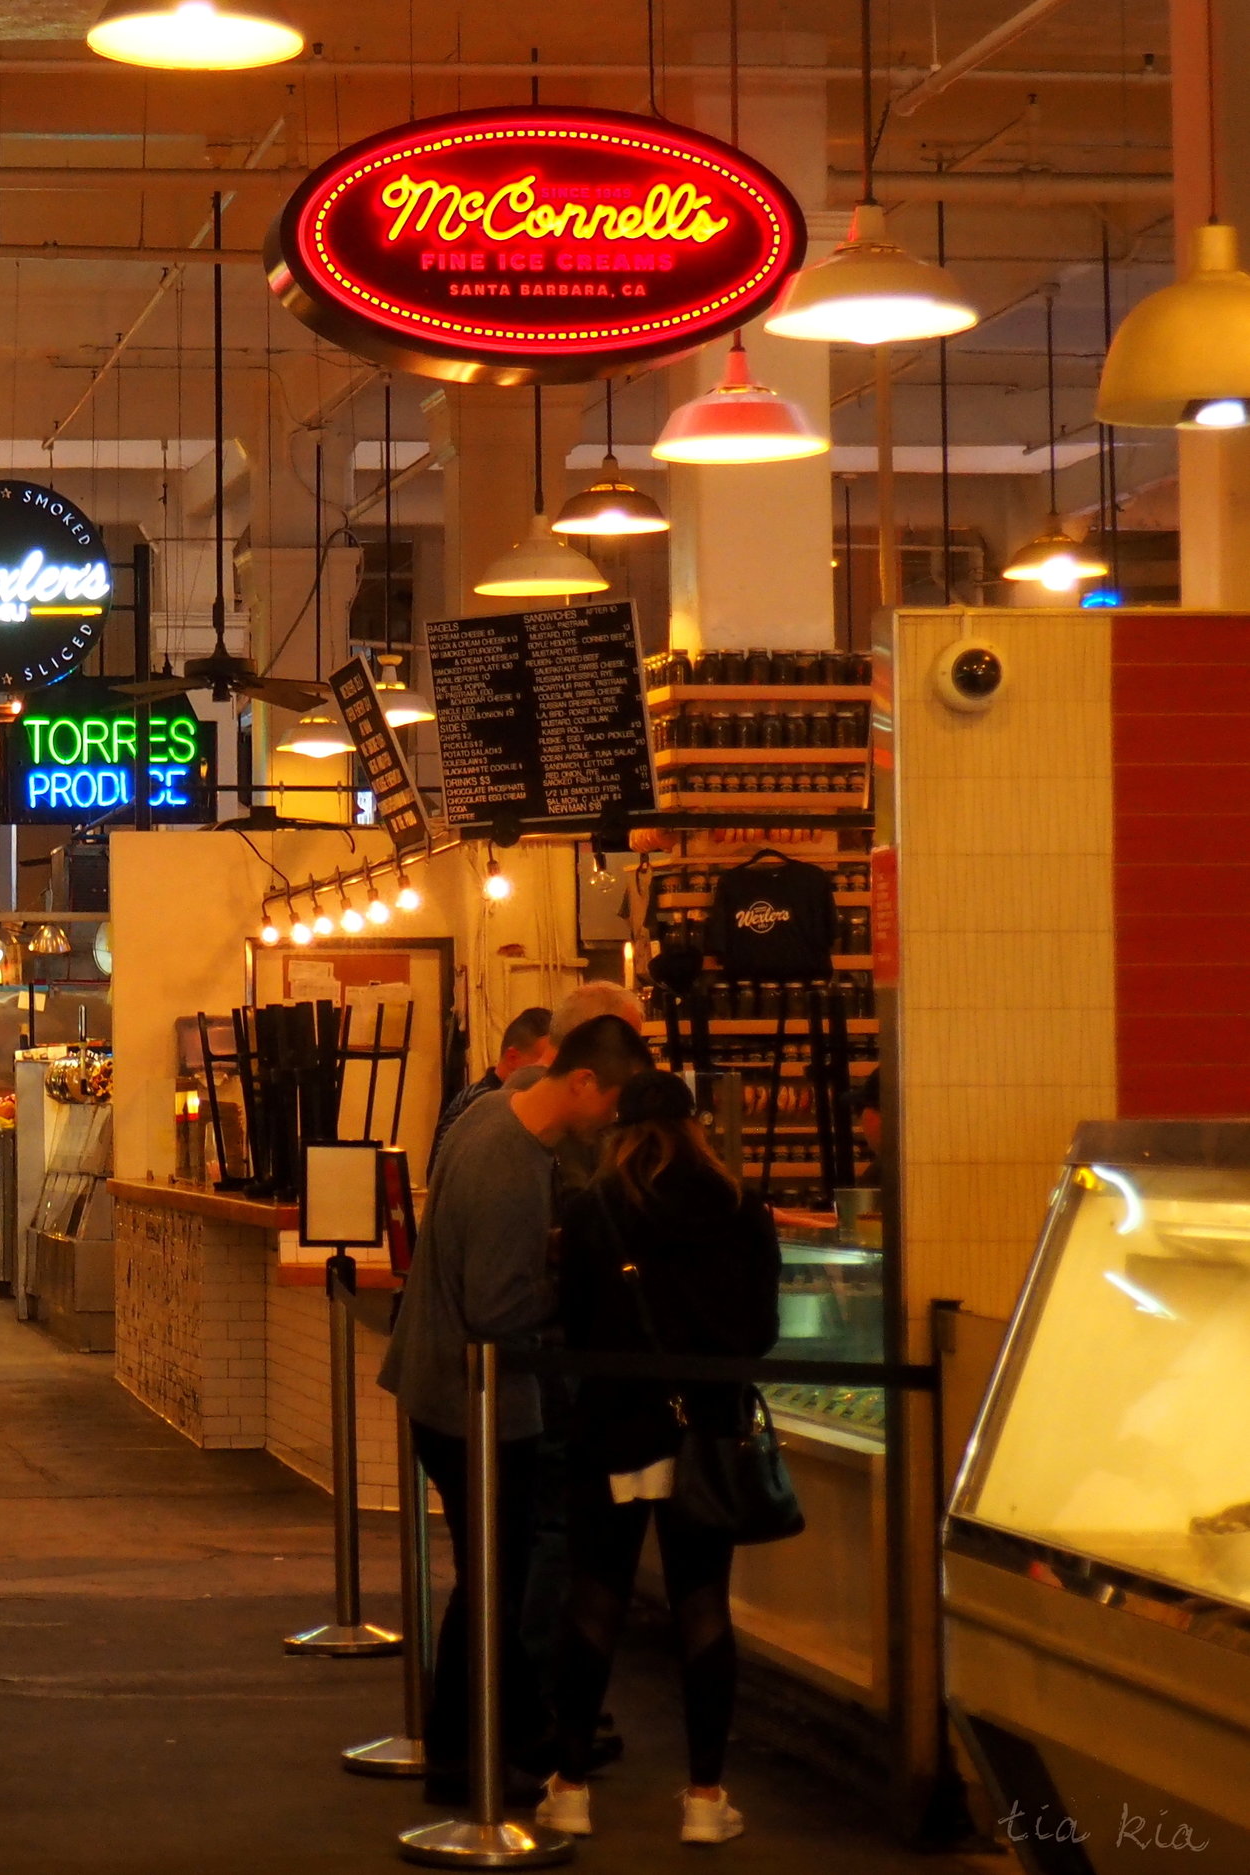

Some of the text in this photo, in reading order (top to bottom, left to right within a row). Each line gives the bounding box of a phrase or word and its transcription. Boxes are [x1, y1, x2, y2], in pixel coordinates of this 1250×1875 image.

[382, 174, 729, 242] McConnell's
[421, 253, 674, 271] FINE ICE CREAMS
[449, 284, 647, 298] SANTA BARBARA, CA
[22, 489, 91, 546] SMOKED
[428, 622, 459, 633] BAGELS
[23, 623, 93, 682] SLICED
[22, 716, 196, 765] TORRES
[445, 776, 477, 787] DRINKS
